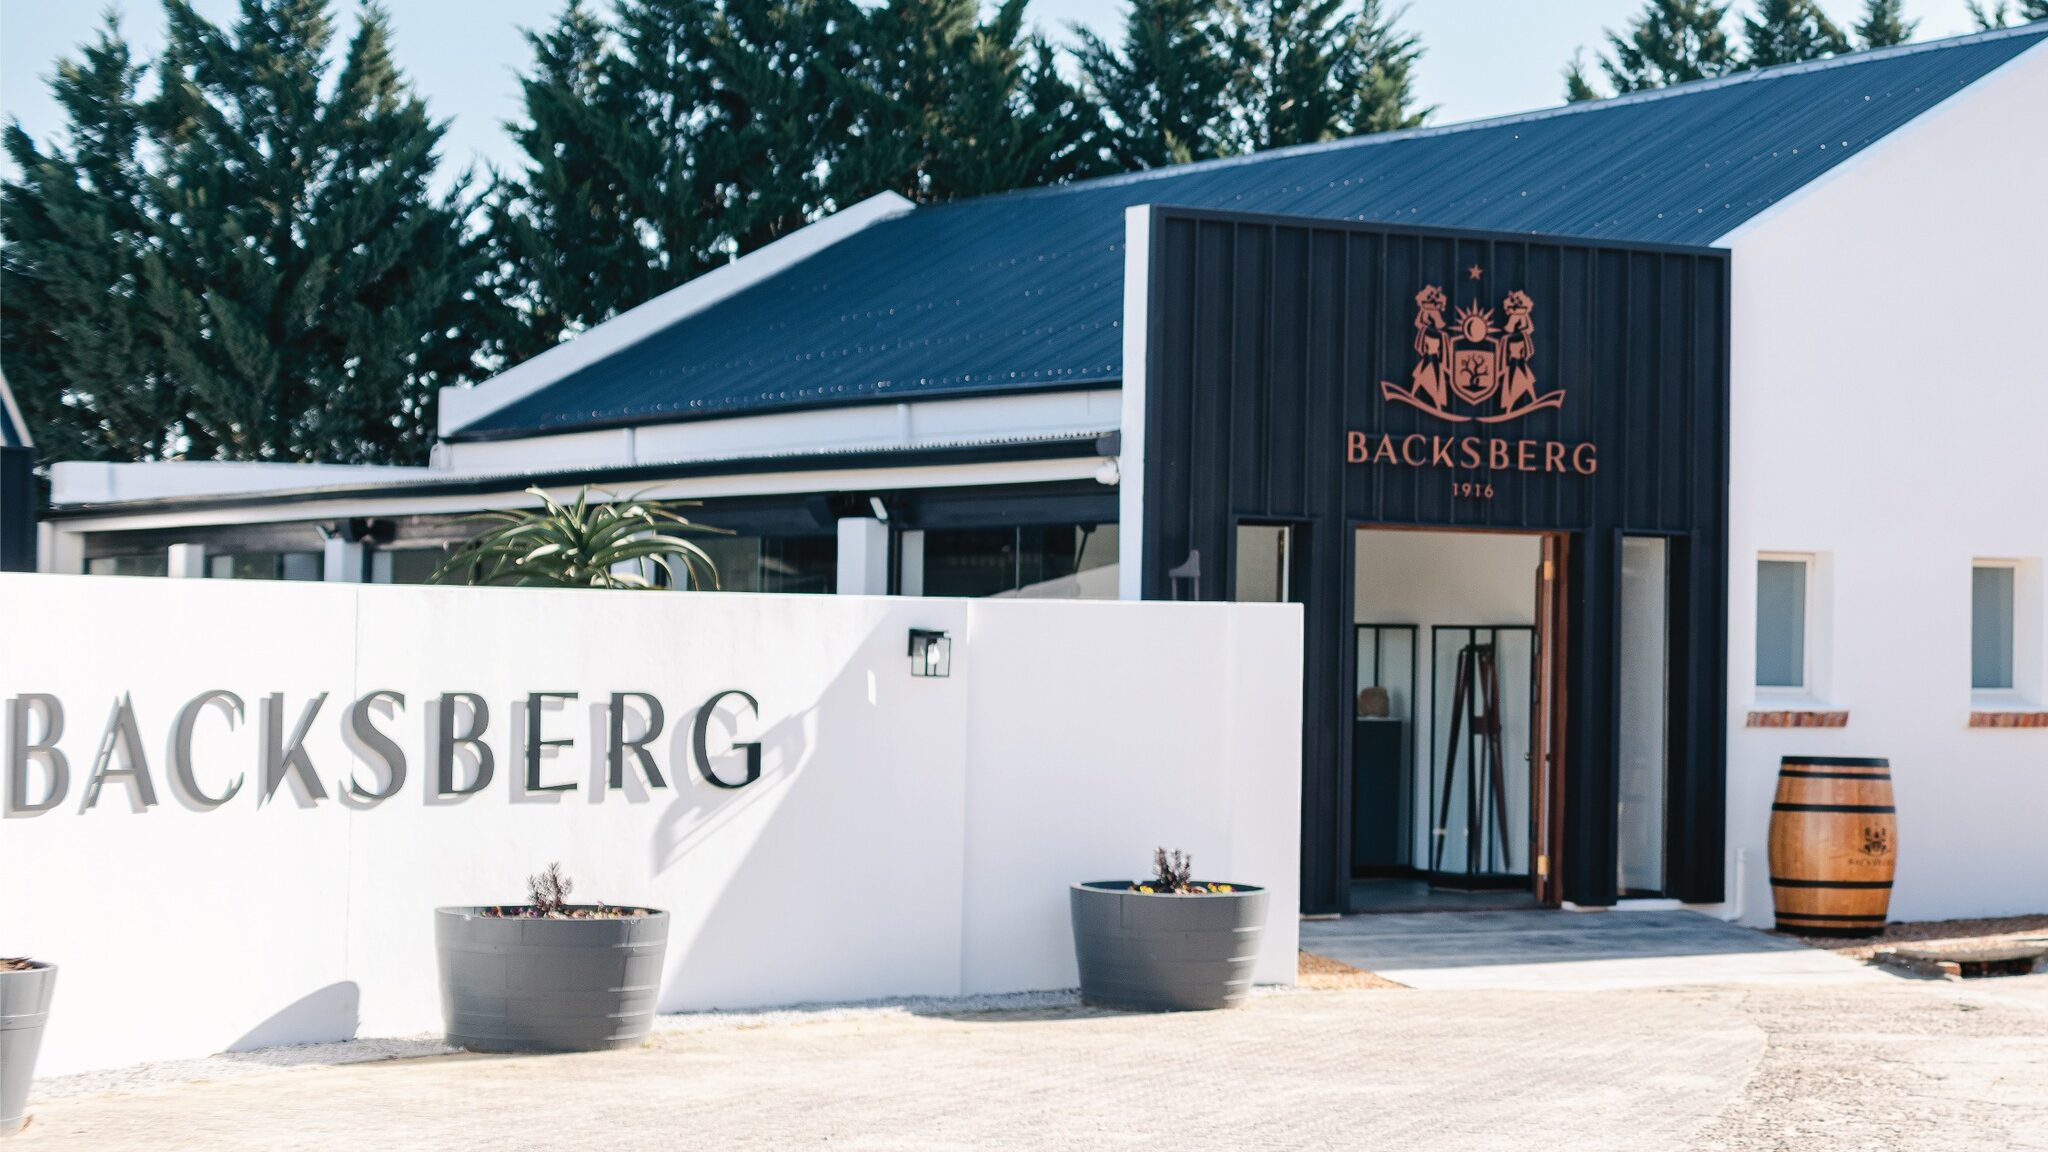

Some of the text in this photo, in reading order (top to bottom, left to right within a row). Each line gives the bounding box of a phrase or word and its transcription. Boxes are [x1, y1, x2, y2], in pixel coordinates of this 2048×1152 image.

[1347, 430, 1598, 475] BACKSBERG
[1452, 482, 1494, 498] 1916
[9, 689, 762, 812] BACKSBERG
